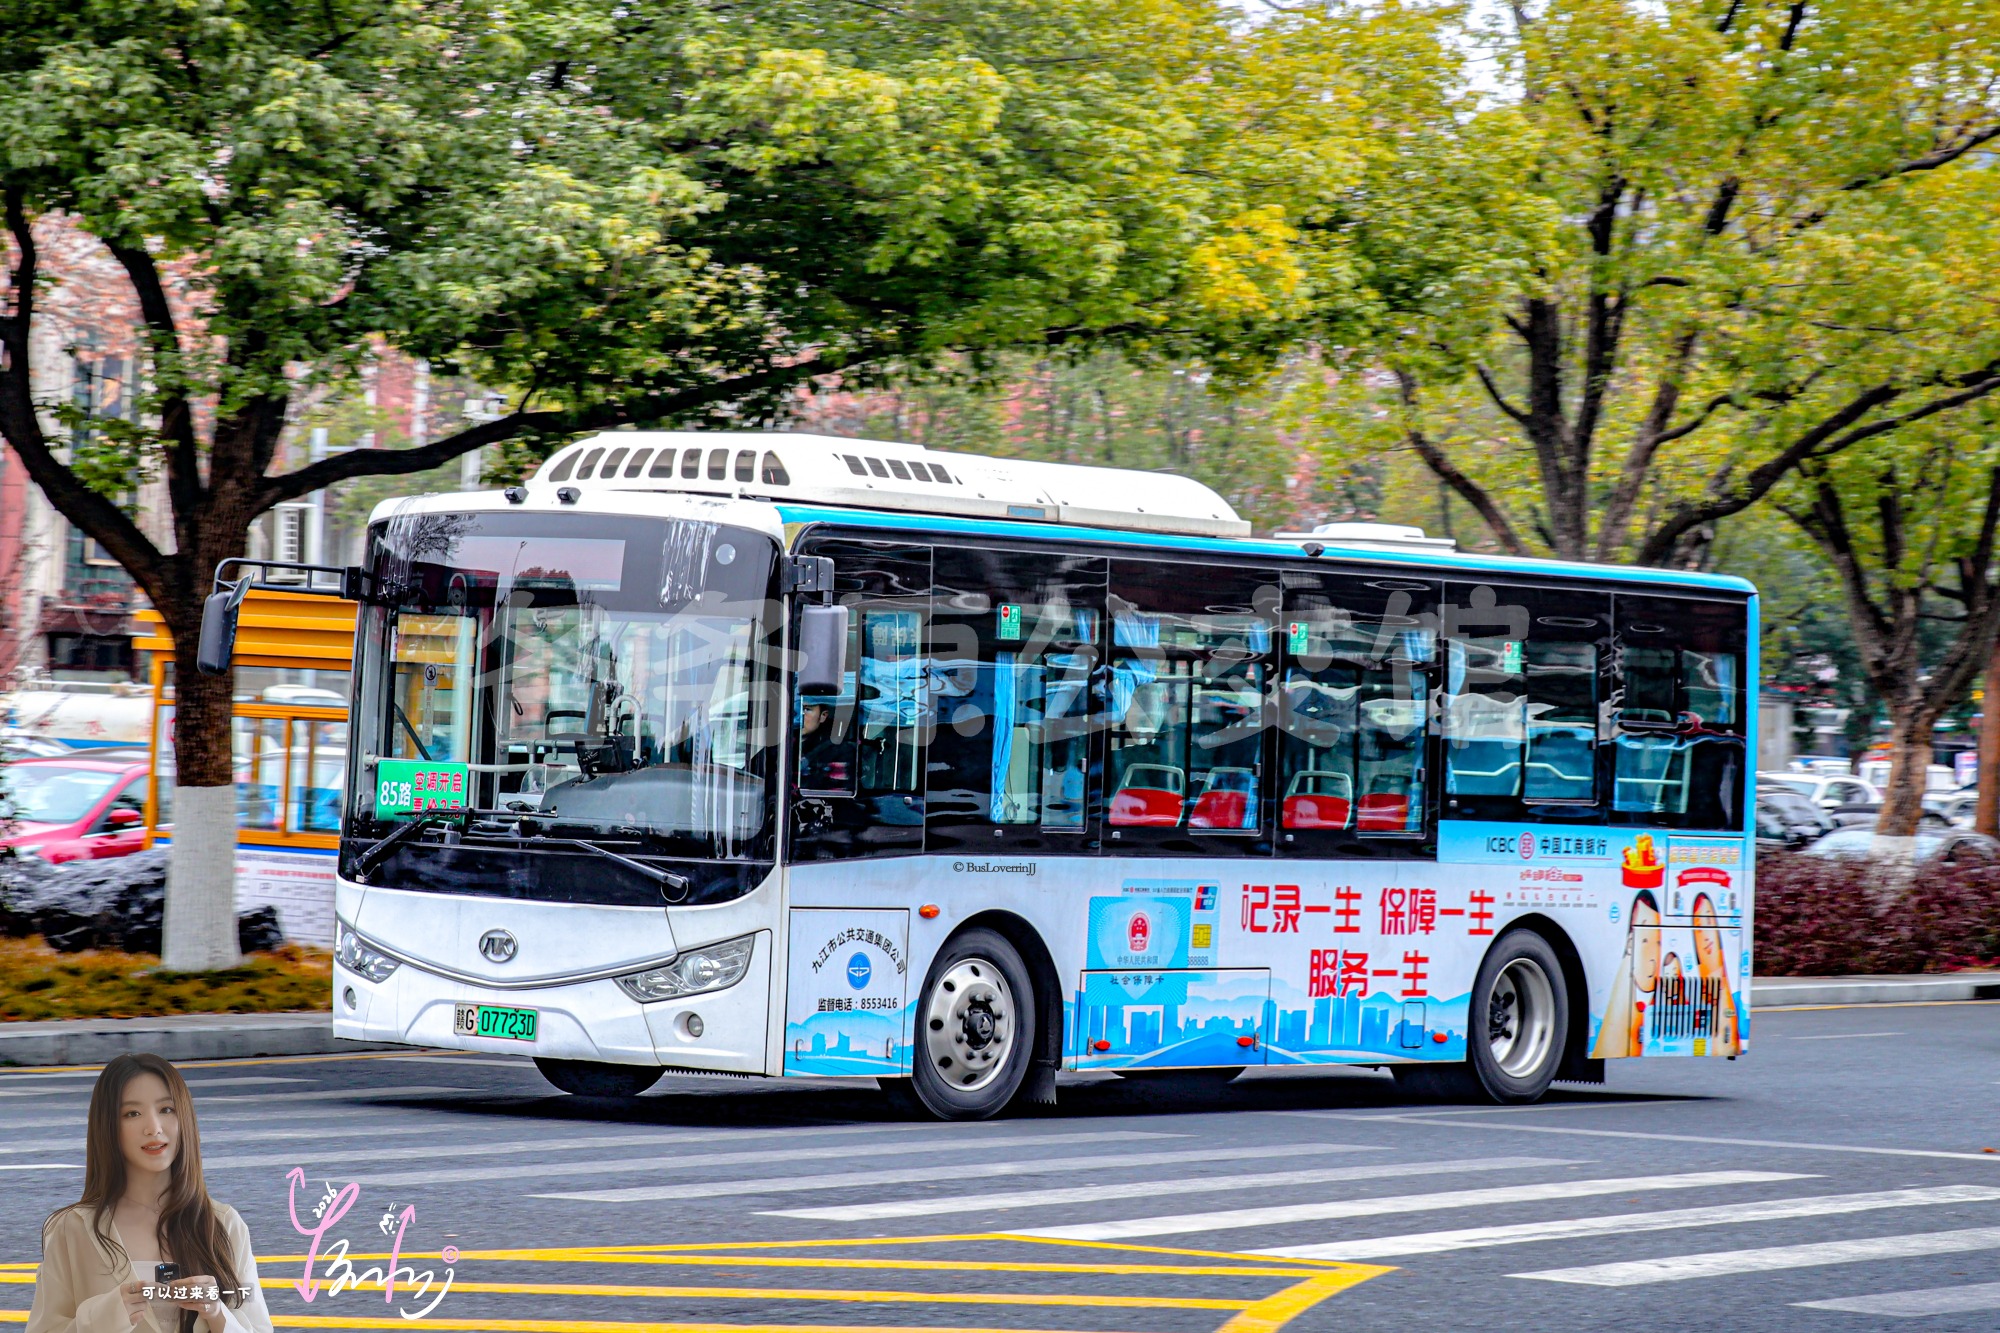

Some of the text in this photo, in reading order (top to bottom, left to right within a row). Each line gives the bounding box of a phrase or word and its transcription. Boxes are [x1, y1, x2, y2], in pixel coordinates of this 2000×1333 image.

[414, 771, 463, 792] 空调开启
[380, 781, 412, 806] 85路
[1486, 836, 1608, 855] ICBC 中国工商银行
[1241, 884, 1495, 936] 记录一生 保障一生
[812, 927, 906, 975] 九江市公共交通集团公司
[1117, 955, 1159, 966] 中华人民共和国
[1110, 975, 1164, 986] 社会保障卡
[1308, 949, 1429, 997] 服务一生
